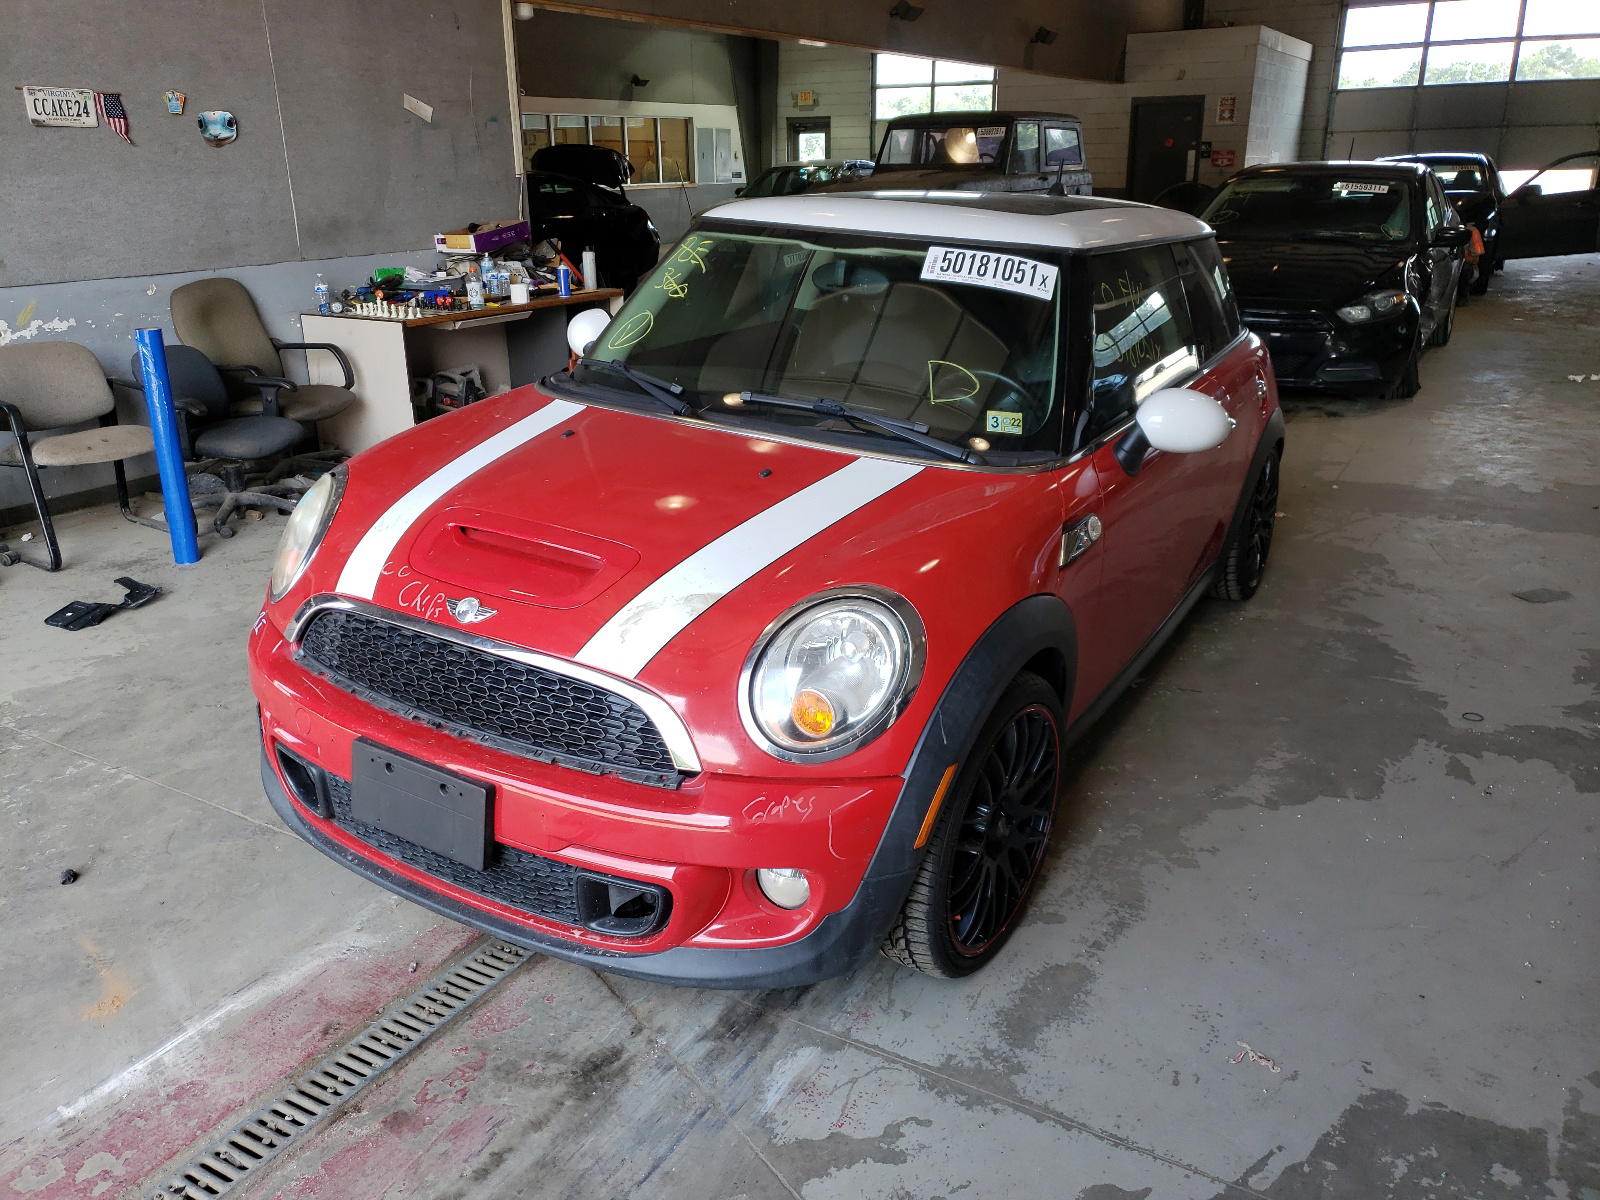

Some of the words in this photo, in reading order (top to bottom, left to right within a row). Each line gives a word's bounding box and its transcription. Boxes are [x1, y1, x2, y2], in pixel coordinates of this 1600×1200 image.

[42, 89, 77, 98] VIRGINIA
[33, 98, 90, 117] CCAKE24
[1011, 417, 1022, 427] 22
